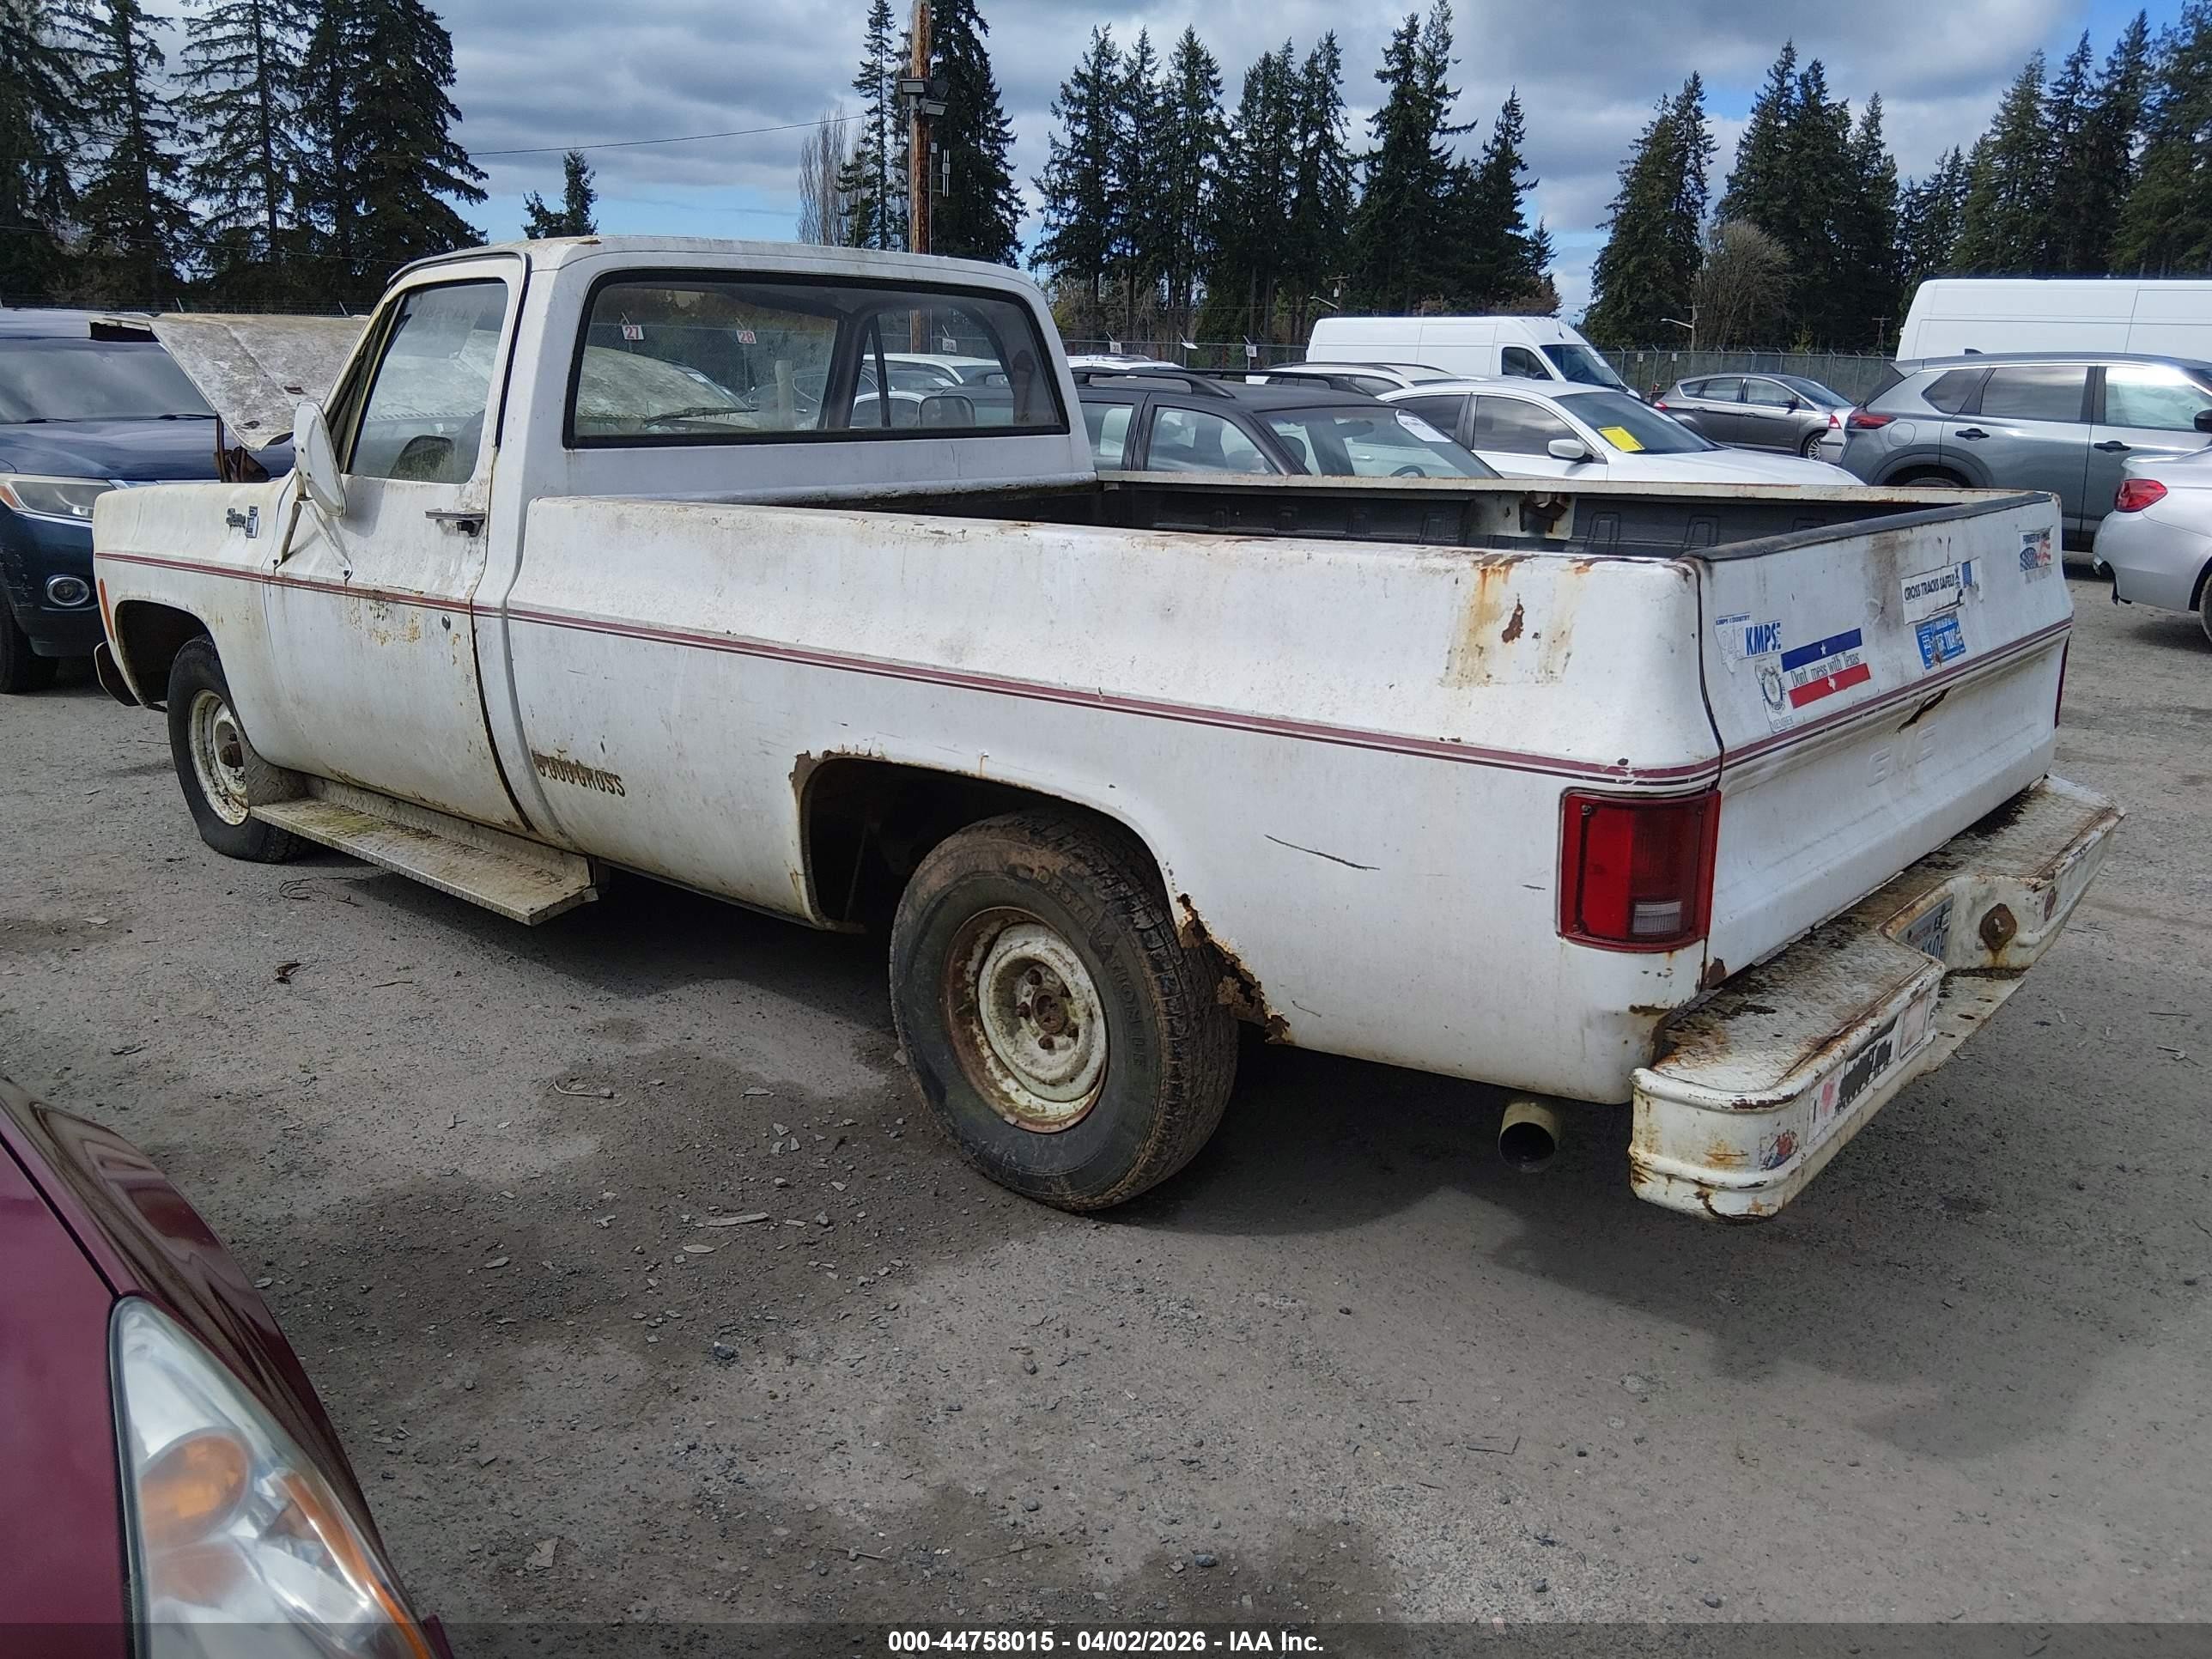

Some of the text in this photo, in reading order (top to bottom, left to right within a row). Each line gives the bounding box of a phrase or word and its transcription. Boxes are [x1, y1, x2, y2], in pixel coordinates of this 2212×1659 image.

[625, 326, 640, 339] 27
[738, 332, 755, 343] 28
[1904, 583, 1921, 601] CROSS
[1921, 577, 1940, 595] TRACKS
[1940, 573, 1955, 591] SAFELY
[1746, 623, 1777, 655] KMPS
[1810, 663, 1828, 681] mess
[1827, 653, 1843, 674] with
[1841, 651, 1861, 668] Texas
